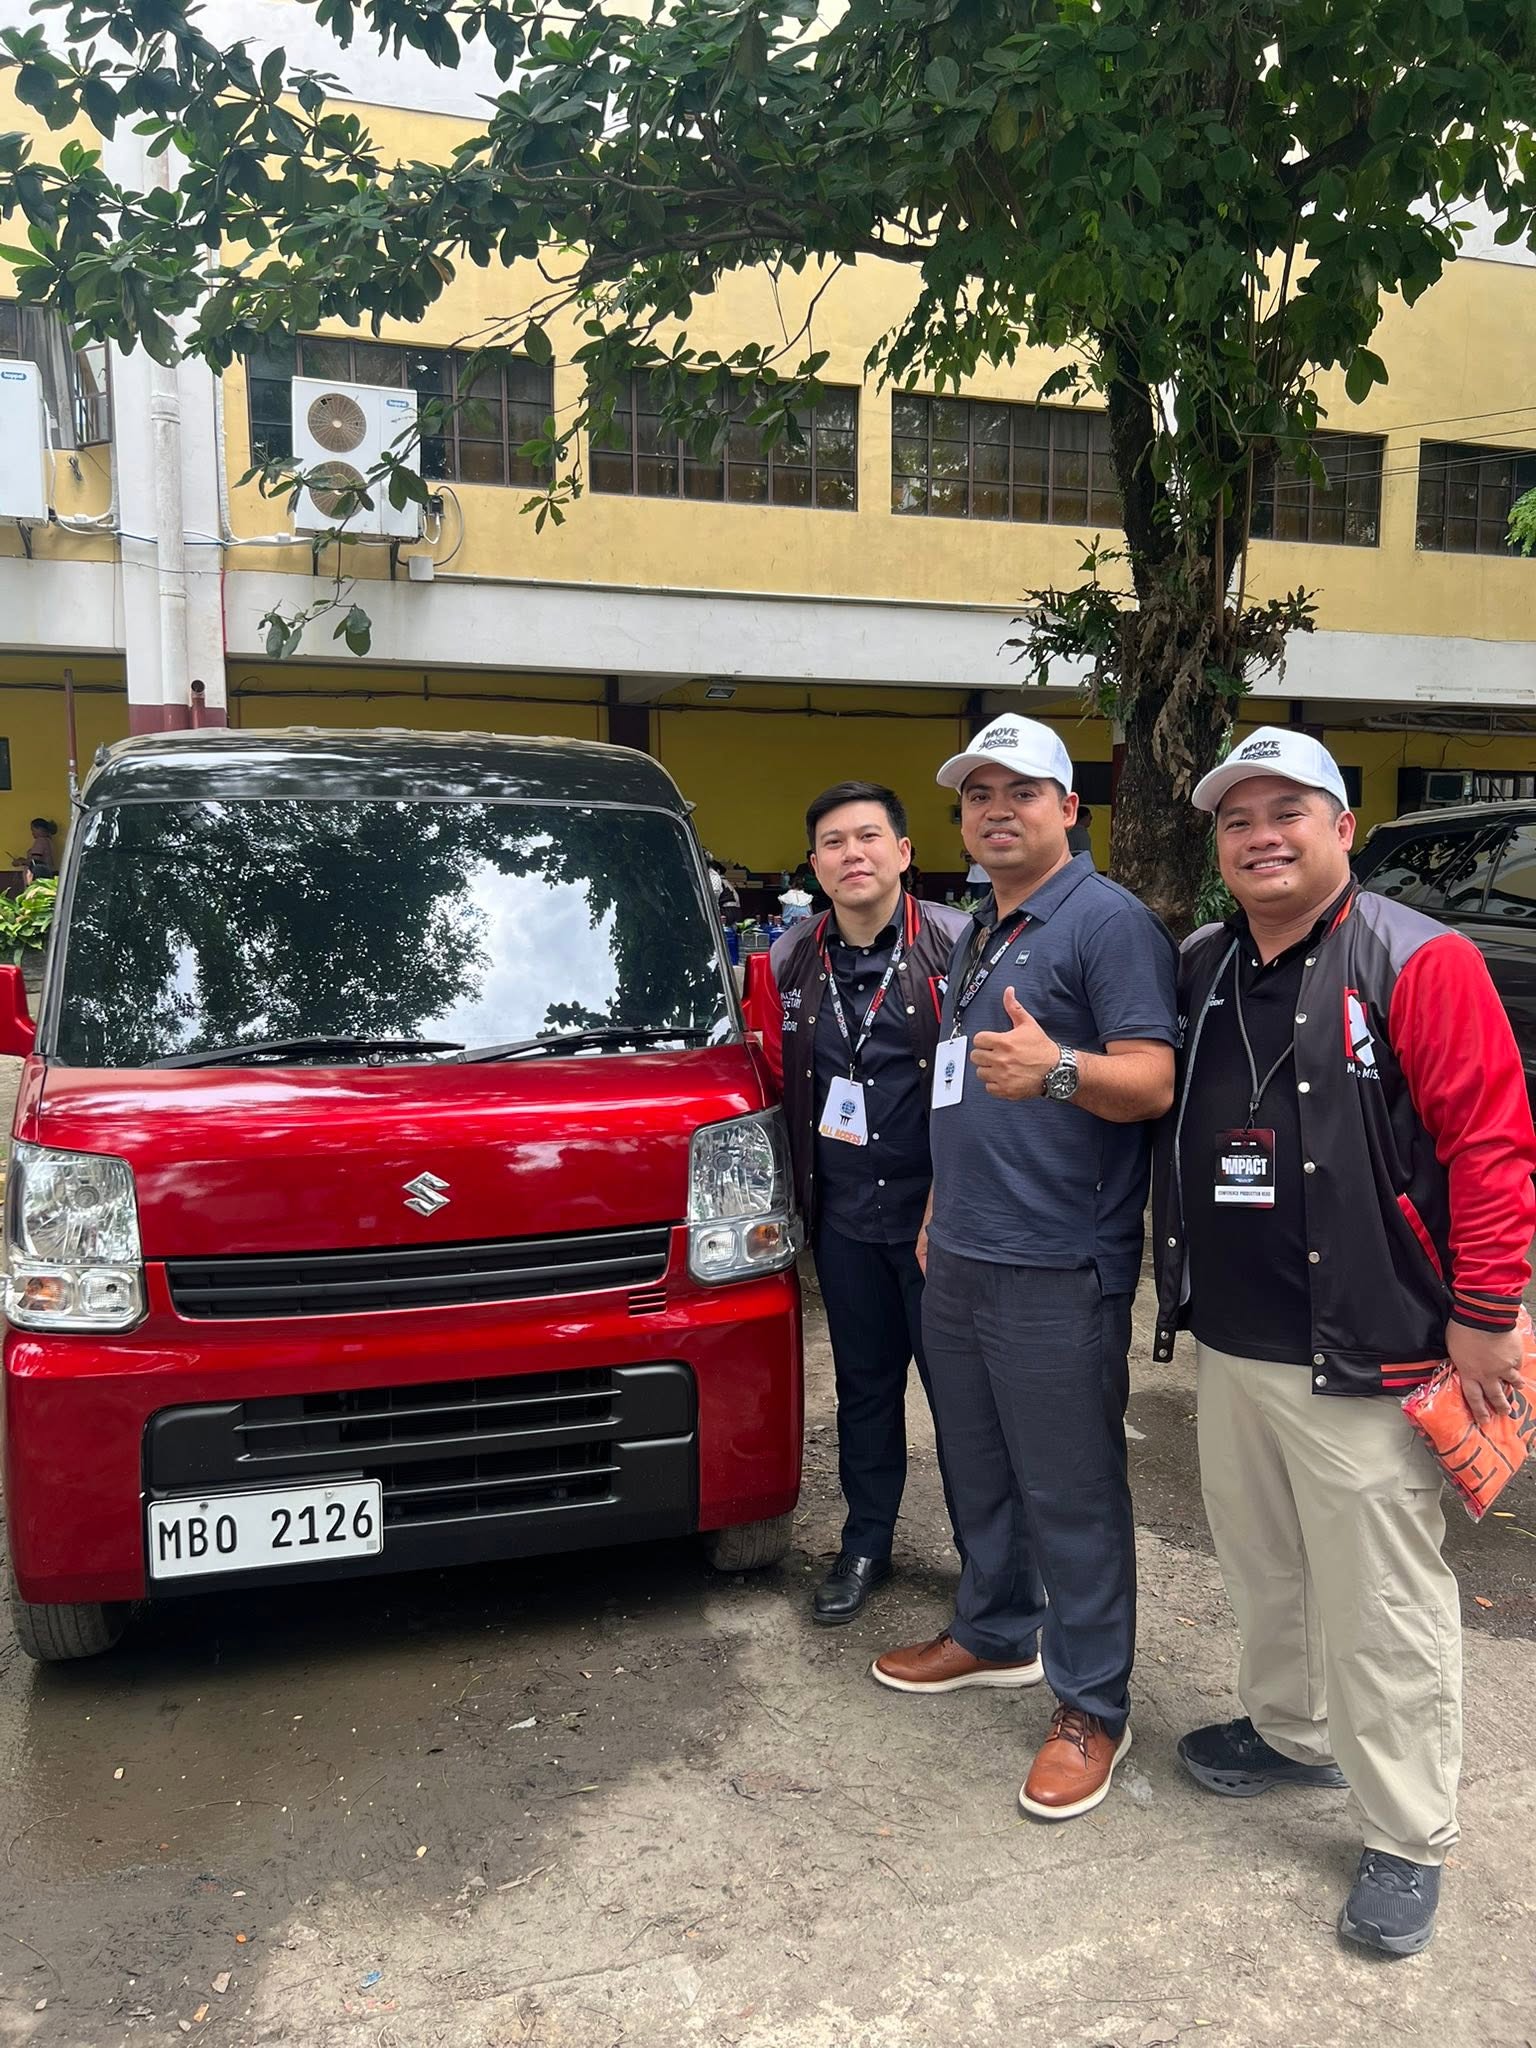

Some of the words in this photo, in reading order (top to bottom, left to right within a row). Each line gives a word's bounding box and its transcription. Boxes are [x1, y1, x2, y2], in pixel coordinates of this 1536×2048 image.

[984, 727, 1020, 741] MOVE
[1241, 740, 1281, 756] MOVE
[1221, 1156, 1268, 1176] IMPACT
[158, 1513, 238, 1561] MBO
[271, 1499, 374, 1549] 2126
